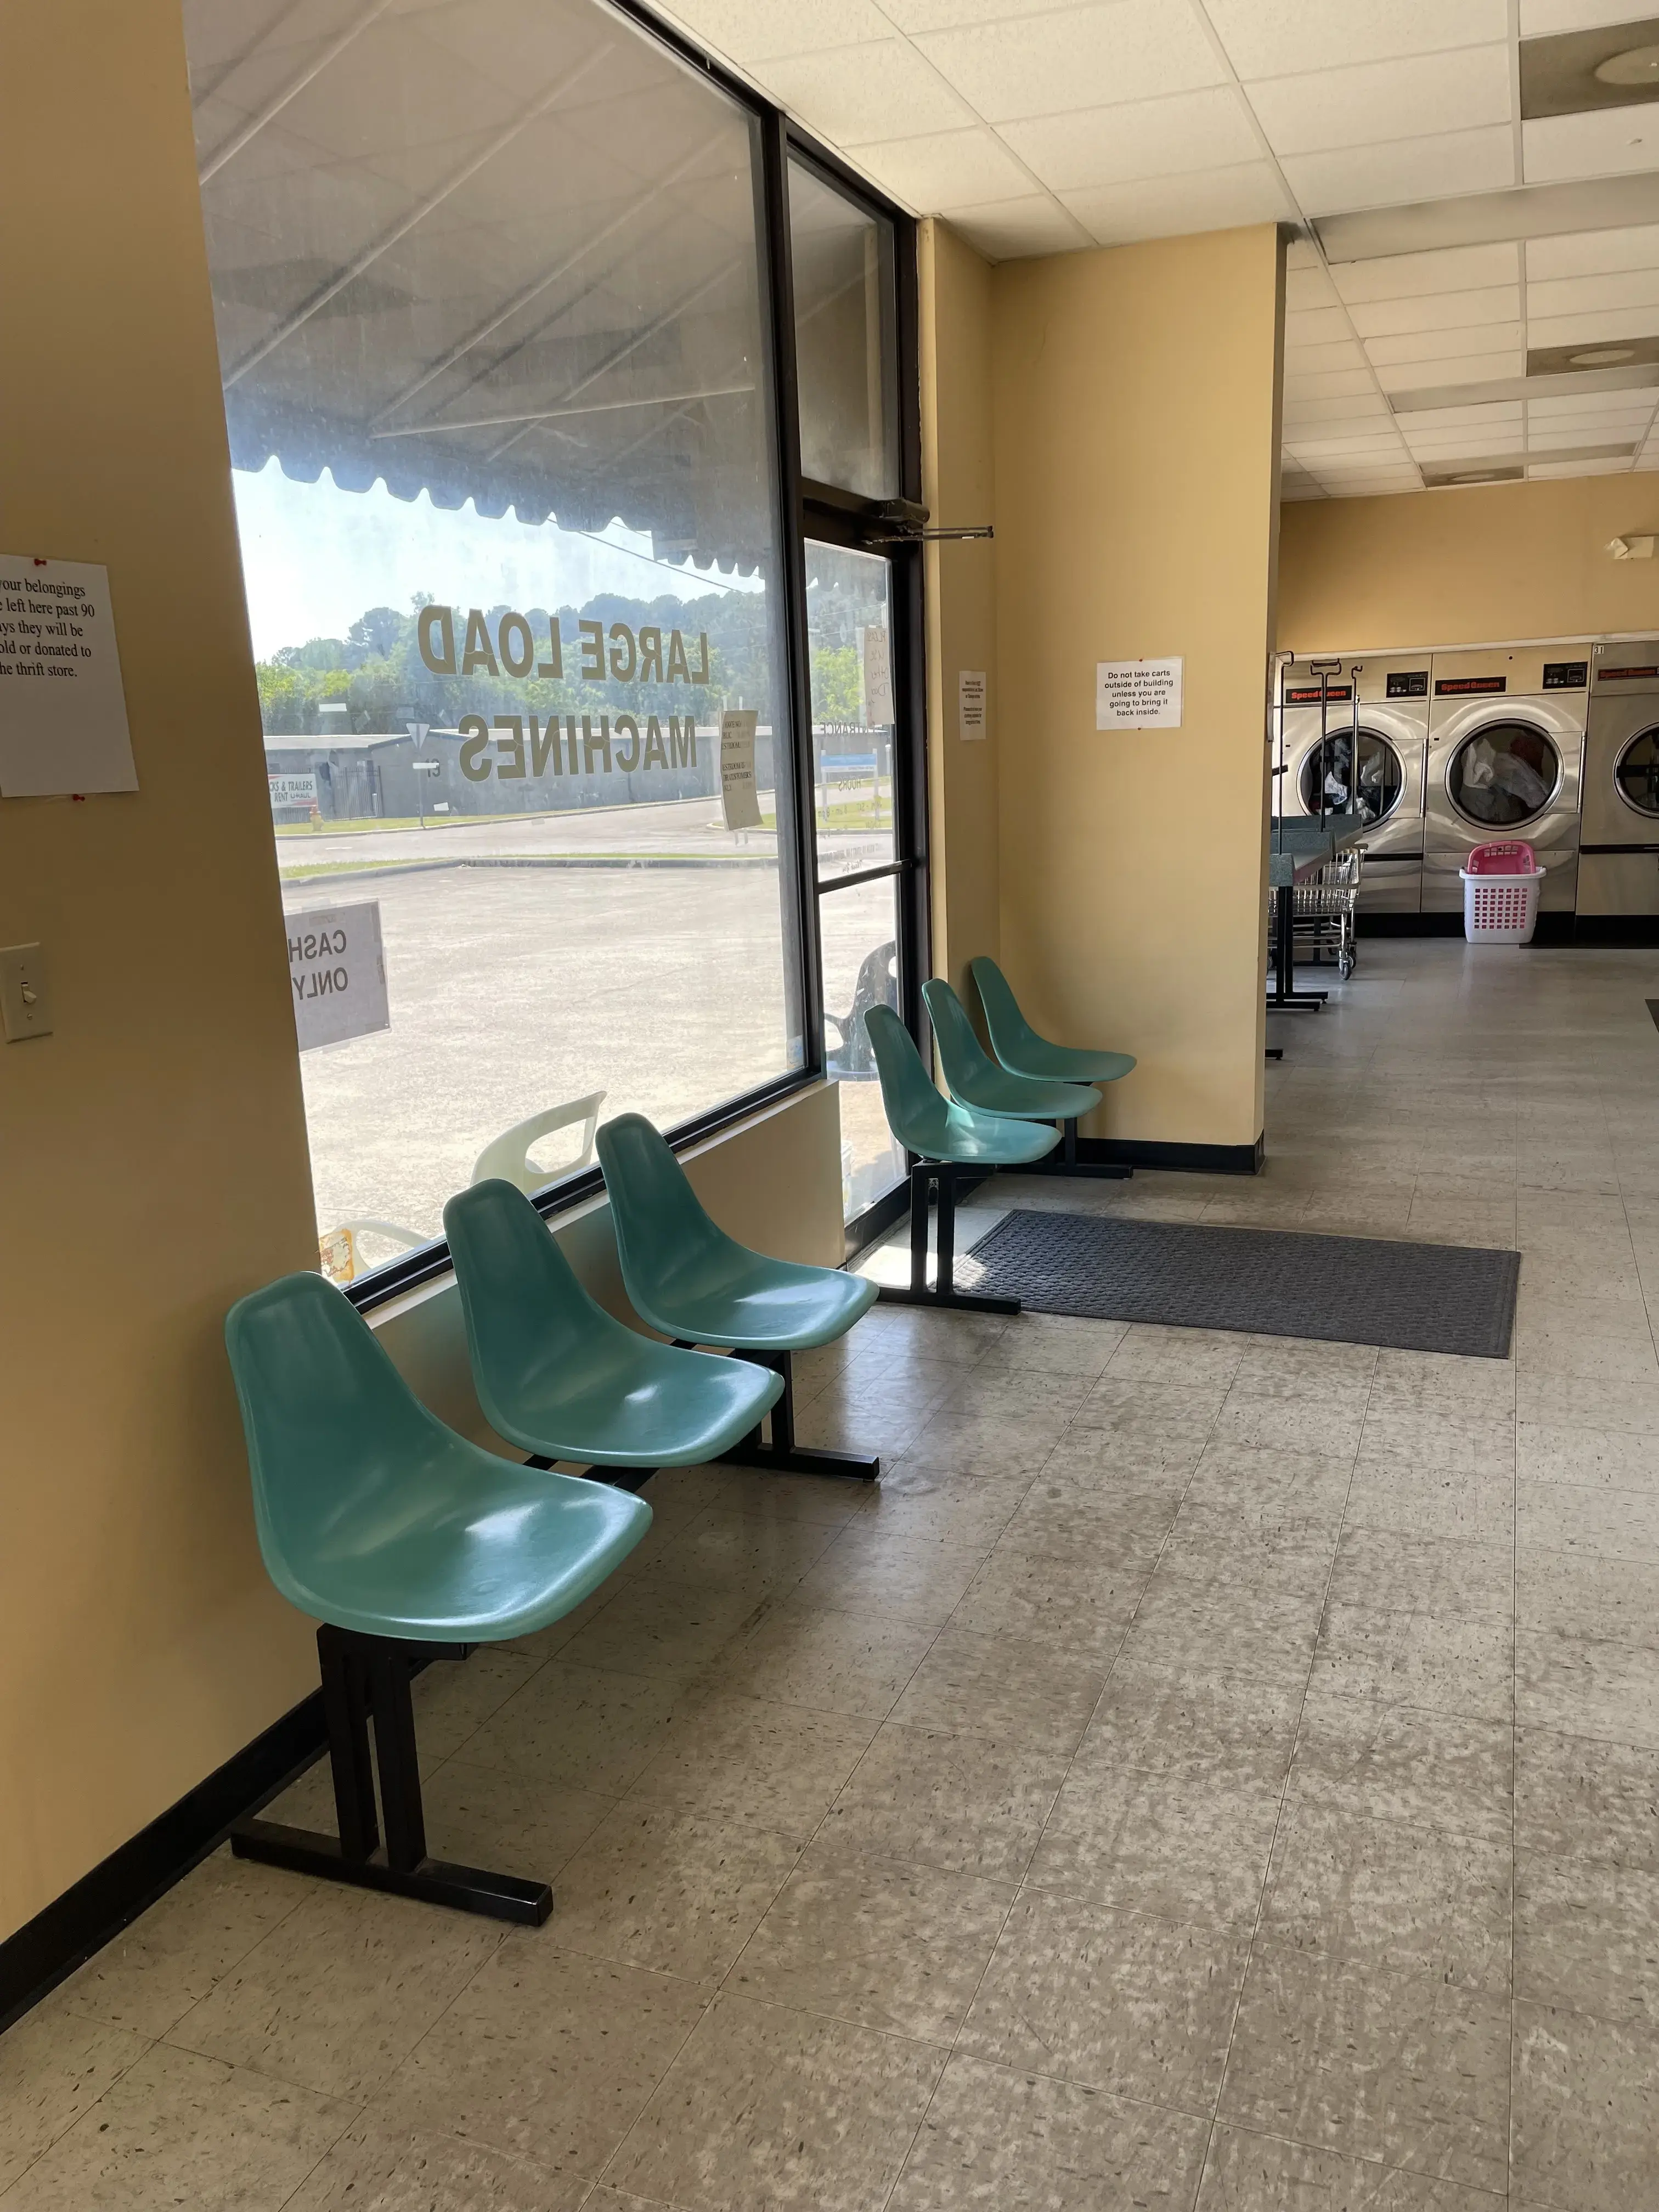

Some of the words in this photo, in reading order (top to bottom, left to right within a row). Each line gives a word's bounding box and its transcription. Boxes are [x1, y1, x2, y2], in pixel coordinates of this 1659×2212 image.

[24, 578, 86, 599] belongings
[5, 597, 26, 612] left
[28, 599, 53, 614] here
[56, 605, 78, 618] past
[81, 603, 94, 617] 90
[18, 619, 42, 637] they
[46, 622, 67, 635] will
[70, 623, 83, 636] be
[20, 645, 31, 654] or
[35, 641, 78, 657] donated
[81, 646, 92, 657] to
[16, 662, 45, 675] thrift
[48, 665, 77, 677] store.
[1441, 682, 1470, 692] Speed
[1470, 681, 1500, 689] Queen
[1291, 690, 1319, 700] Speed
[1109, 701, 1130, 709] going
[729, 771, 752, 780] CUSTOMERS
[281, 781, 286, 791] &
[288, 781, 313, 791] TRAILERS
[274, 792, 288, 802] RENT
